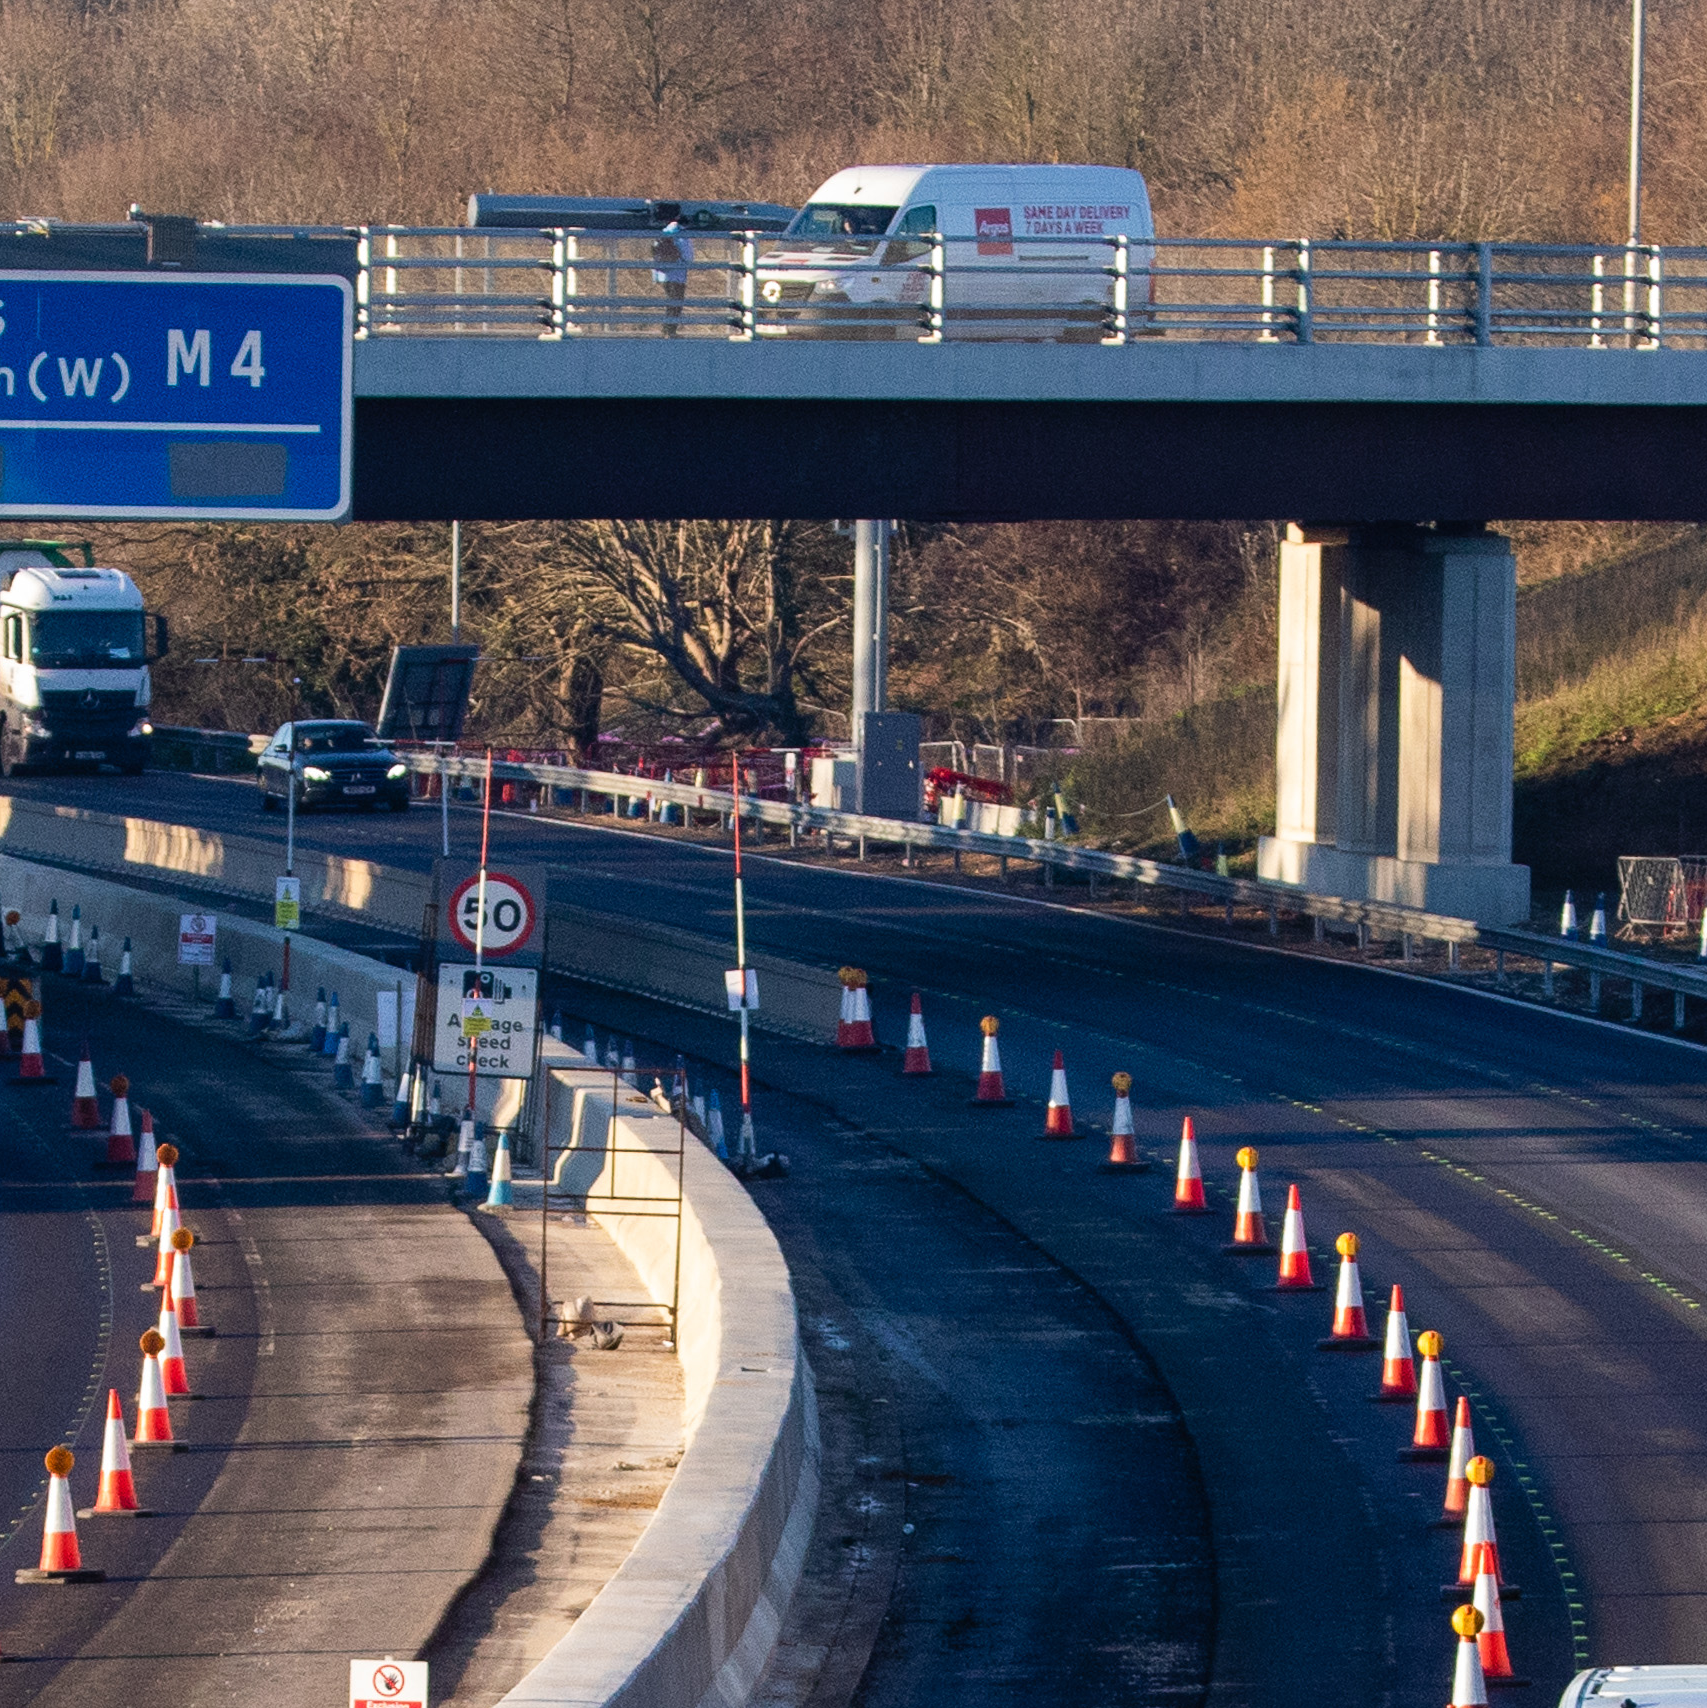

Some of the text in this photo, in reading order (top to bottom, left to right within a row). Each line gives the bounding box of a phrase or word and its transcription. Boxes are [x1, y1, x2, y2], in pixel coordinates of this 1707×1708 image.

[1023, 204, 1131, 220] SAME DAY DELIVERY
[1033, 221, 1063, 235] DAYS
[1064, 221, 1072, 234] A
[1074, 221, 1105, 235] WEEK
[166, 328, 266, 388] M 4
[27, 350, 130, 403] (W)
[463, 896, 522, 933] 50
[447, 1011, 524, 1034] Aage
